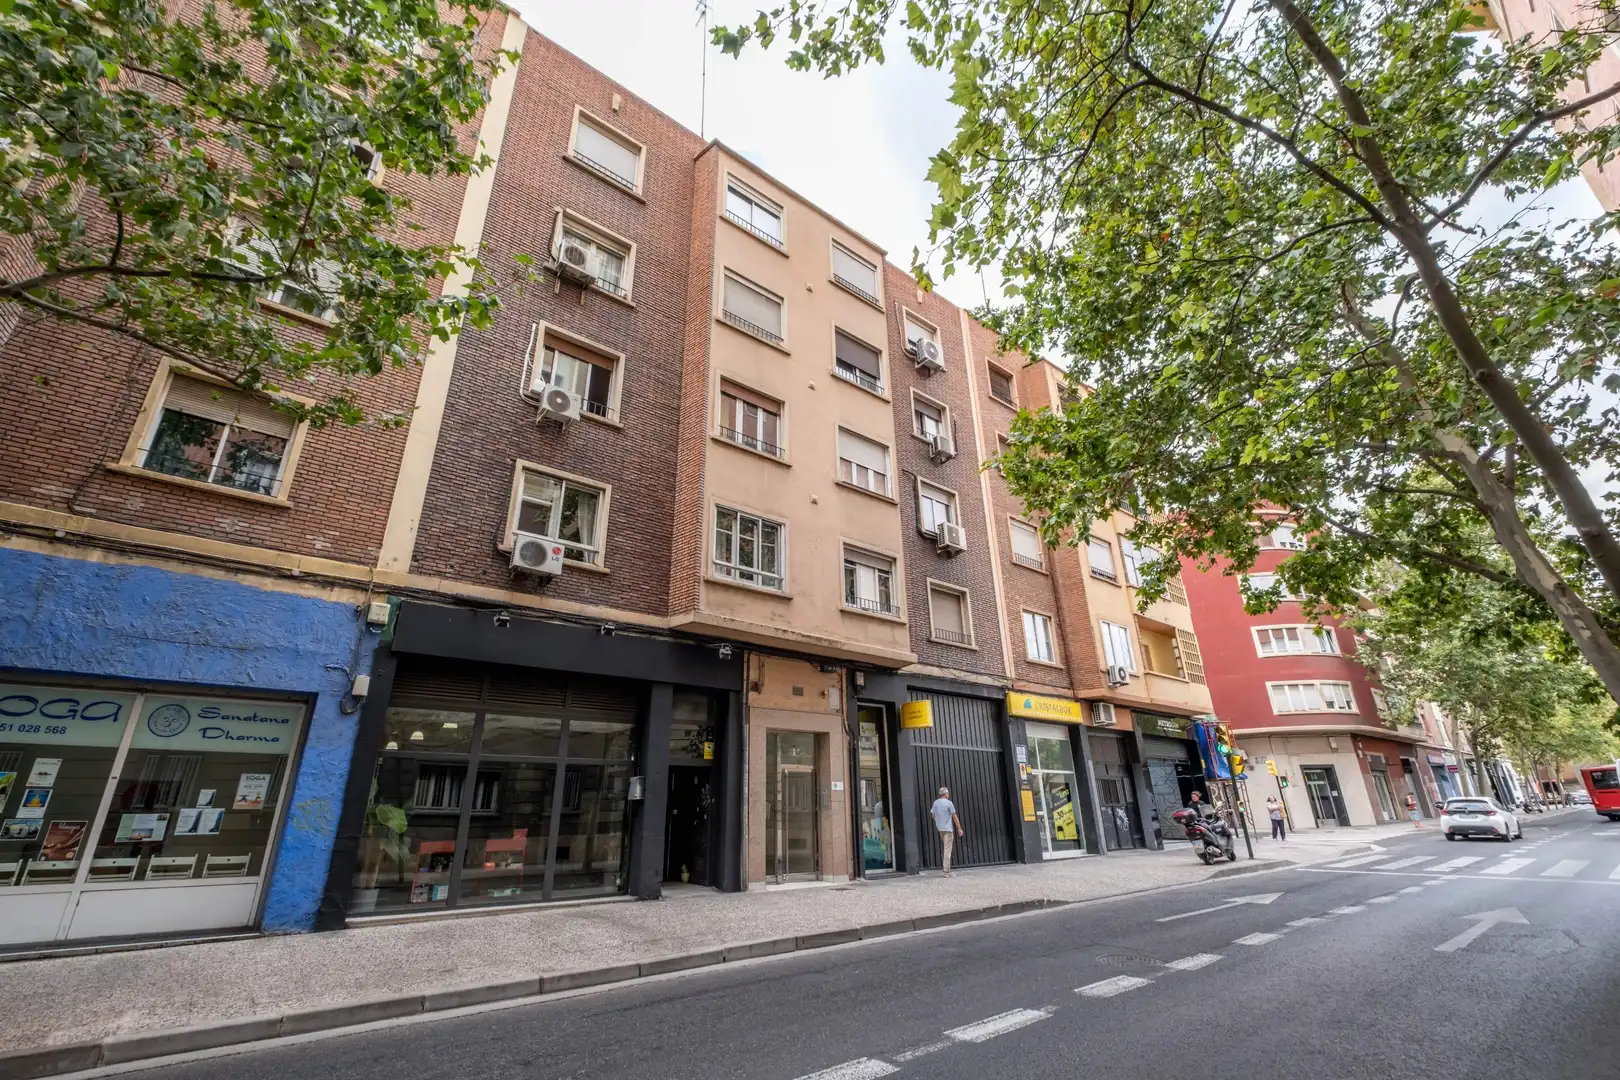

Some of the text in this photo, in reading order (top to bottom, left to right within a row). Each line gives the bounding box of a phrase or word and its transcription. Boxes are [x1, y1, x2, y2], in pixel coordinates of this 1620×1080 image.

[198, 707, 290, 724] Sanatana
[18, 724, 41, 733] 028
[44, 726, 67, 735] 568
[198, 727, 280, 743] Dharma
